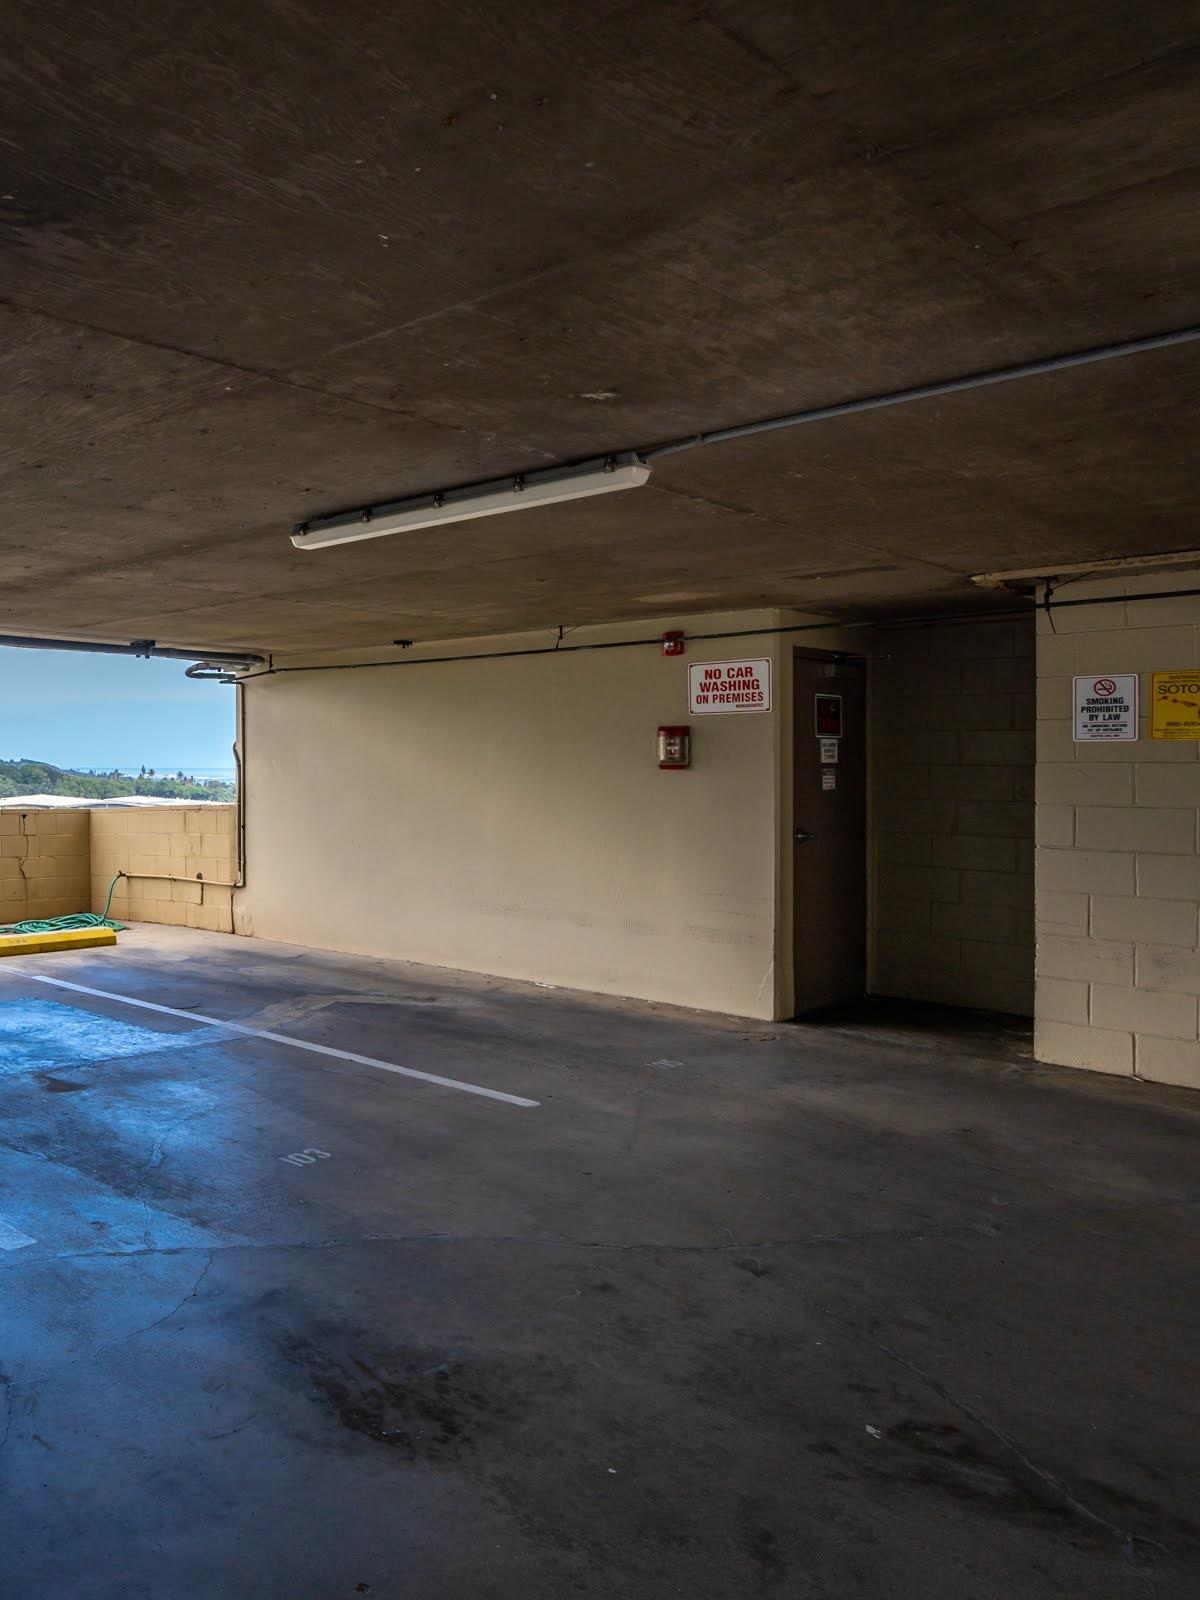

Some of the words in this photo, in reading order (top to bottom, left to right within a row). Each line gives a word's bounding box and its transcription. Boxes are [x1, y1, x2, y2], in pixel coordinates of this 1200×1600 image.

[704, 669, 721, 680] NO
[727, 667, 753, 678] CAR
[700, 679, 760, 692] WASHING
[696, 694, 709, 705] ON
[712, 692, 764, 703] PREMISES
[1086, 697, 1124, 706] SMOKING
[1080, 705, 1130, 713] PROHIBITED
[1088, 714, 1100, 722] BY
[1102, 713, 1121, 721] LAW
